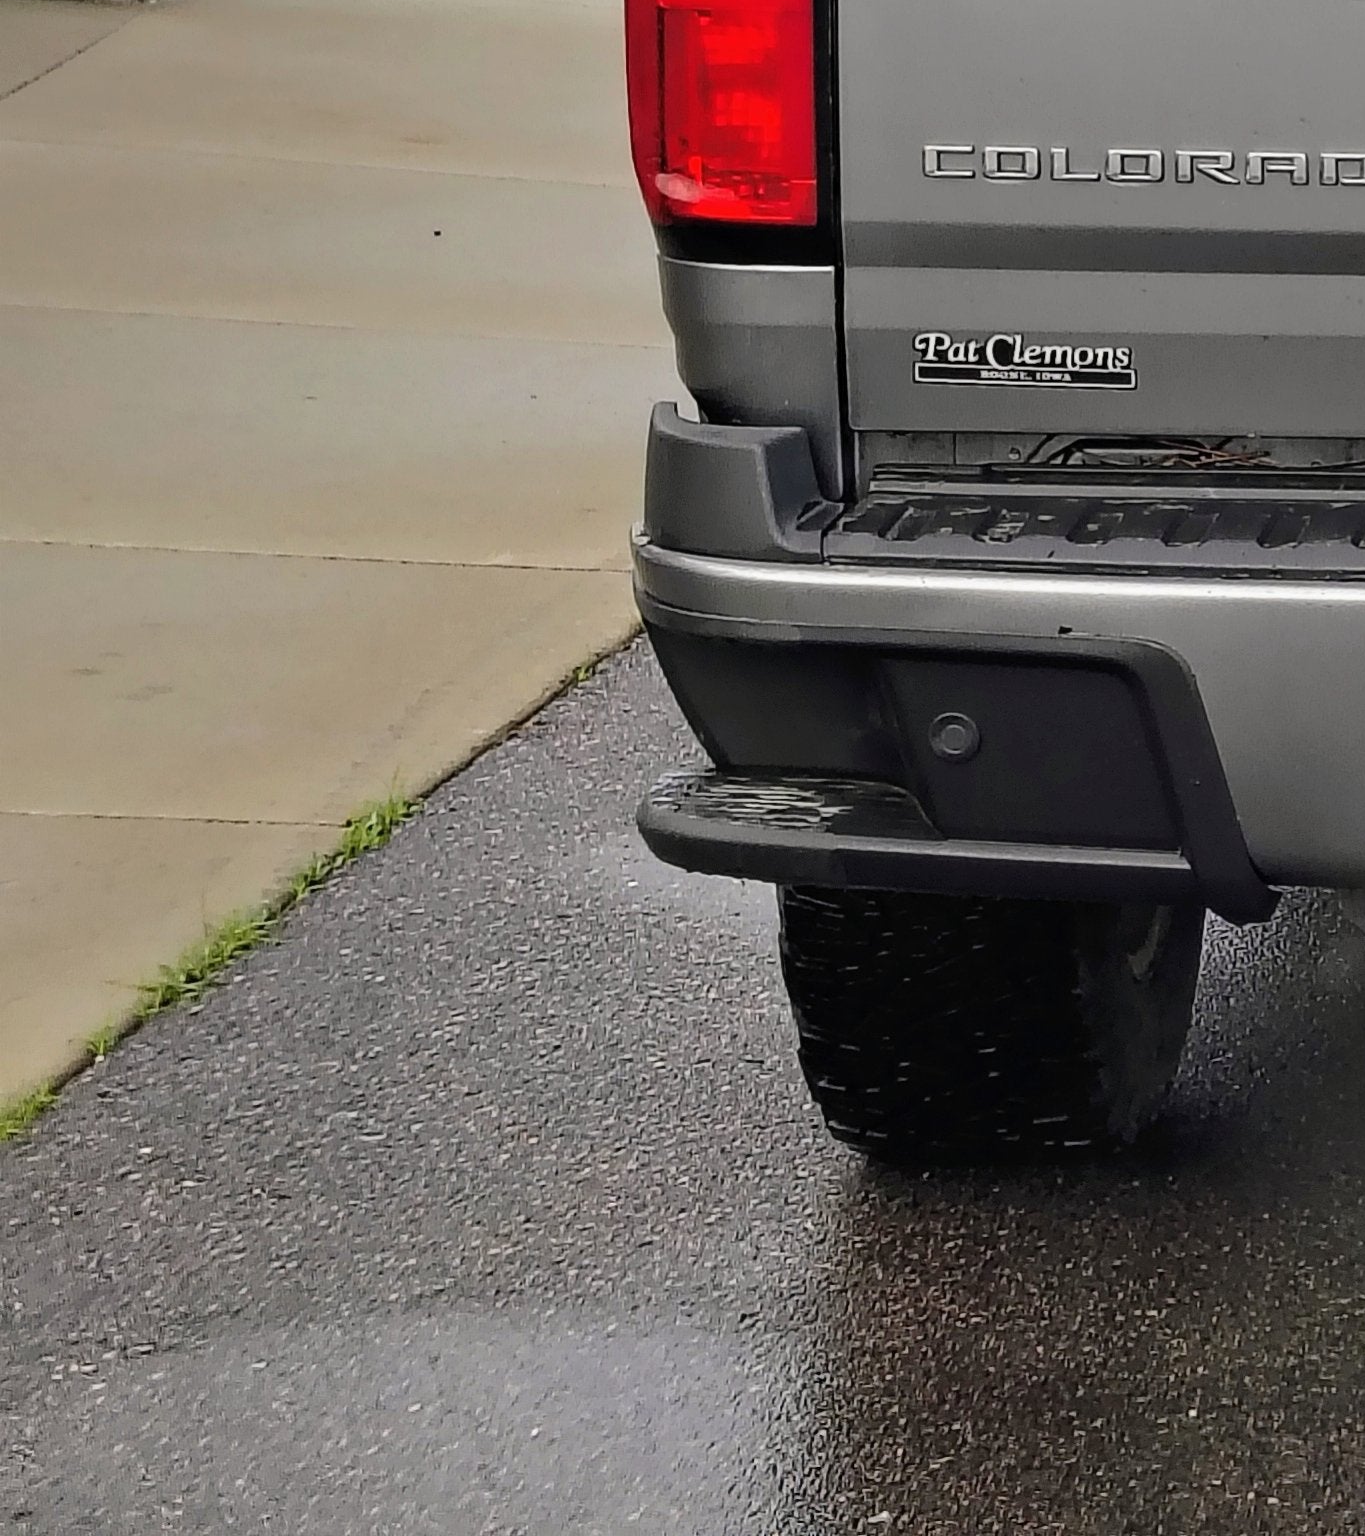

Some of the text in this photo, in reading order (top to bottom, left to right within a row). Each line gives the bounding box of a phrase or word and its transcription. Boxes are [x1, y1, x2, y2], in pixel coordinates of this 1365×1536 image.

[914, 332, 1131, 371] Pat Clemons
[1035, 371, 1072, 382] IOWA
